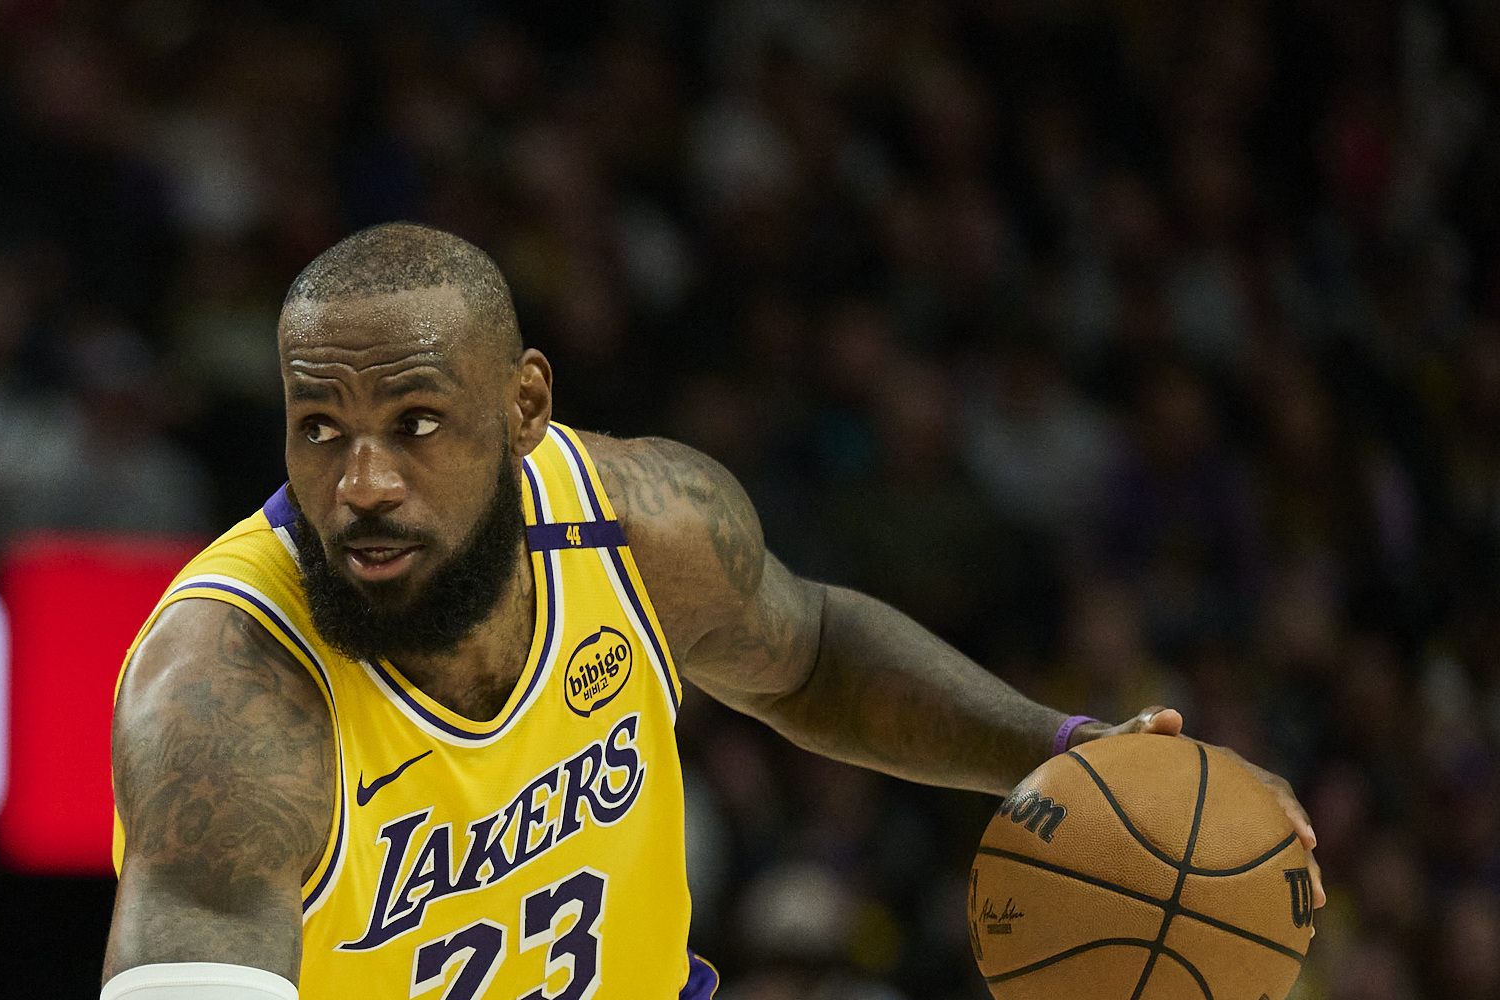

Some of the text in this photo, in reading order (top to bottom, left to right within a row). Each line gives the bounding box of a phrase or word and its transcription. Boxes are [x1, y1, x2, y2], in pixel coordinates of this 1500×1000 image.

[566, 526, 581, 545] 44
[569, 644, 627, 696] bibigo
[584, 677, 609, 700] 비비고
[332, 711, 647, 952] LAKERS
